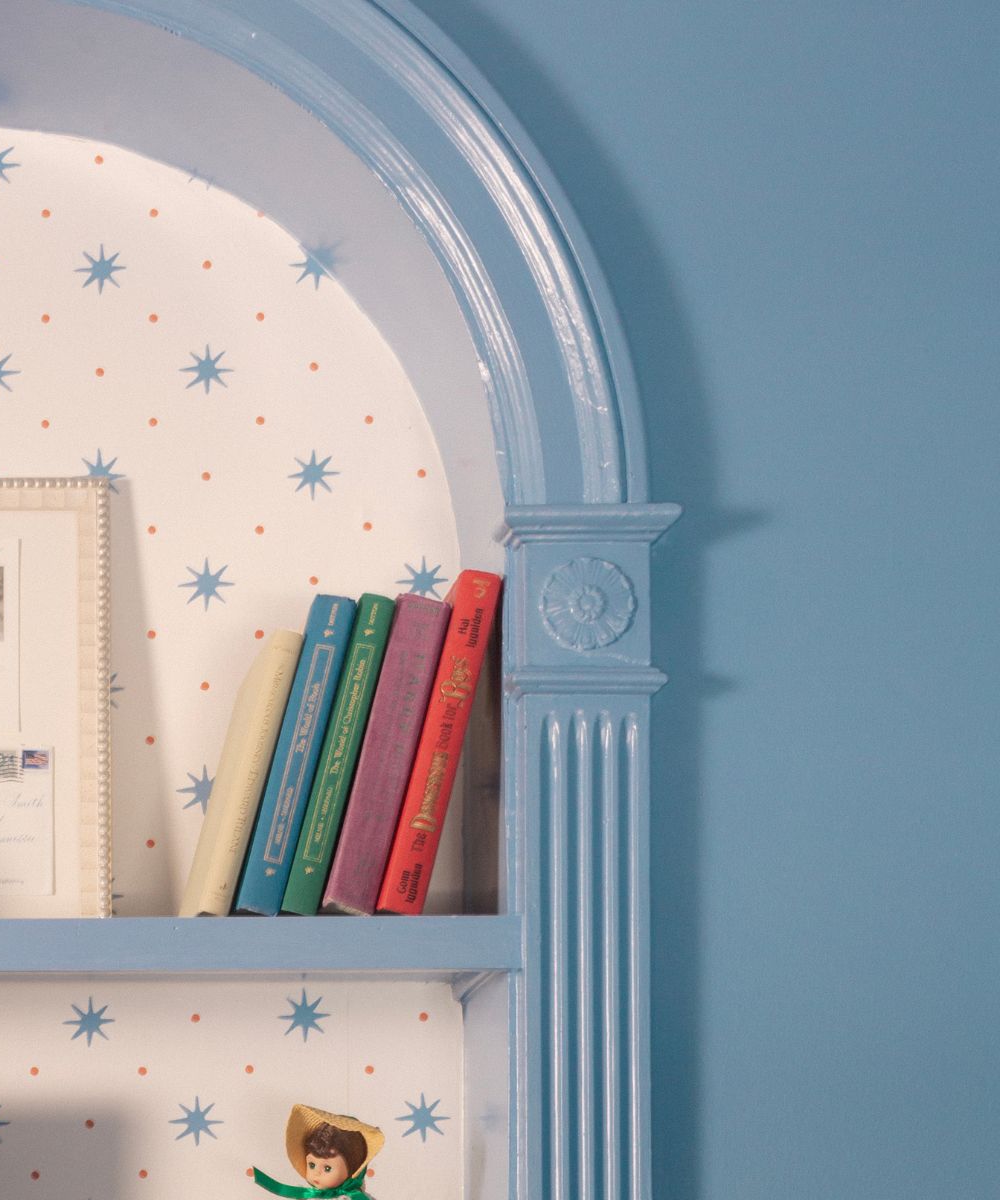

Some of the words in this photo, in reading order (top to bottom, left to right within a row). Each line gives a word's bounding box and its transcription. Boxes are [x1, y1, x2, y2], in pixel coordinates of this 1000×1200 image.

[457, 618, 469, 634] Hal
[352, 658, 366, 681] Robin
[307, 681, 321, 701] Pooh
[342, 681, 361, 725] Christopher
[299, 713, 312, 736] World
[293, 736, 306, 753] The
[333, 735, 346, 758] World
[328, 758, 340, 774] The
[411, 832, 426, 851] The
[436, 722, 454, 749] Book
